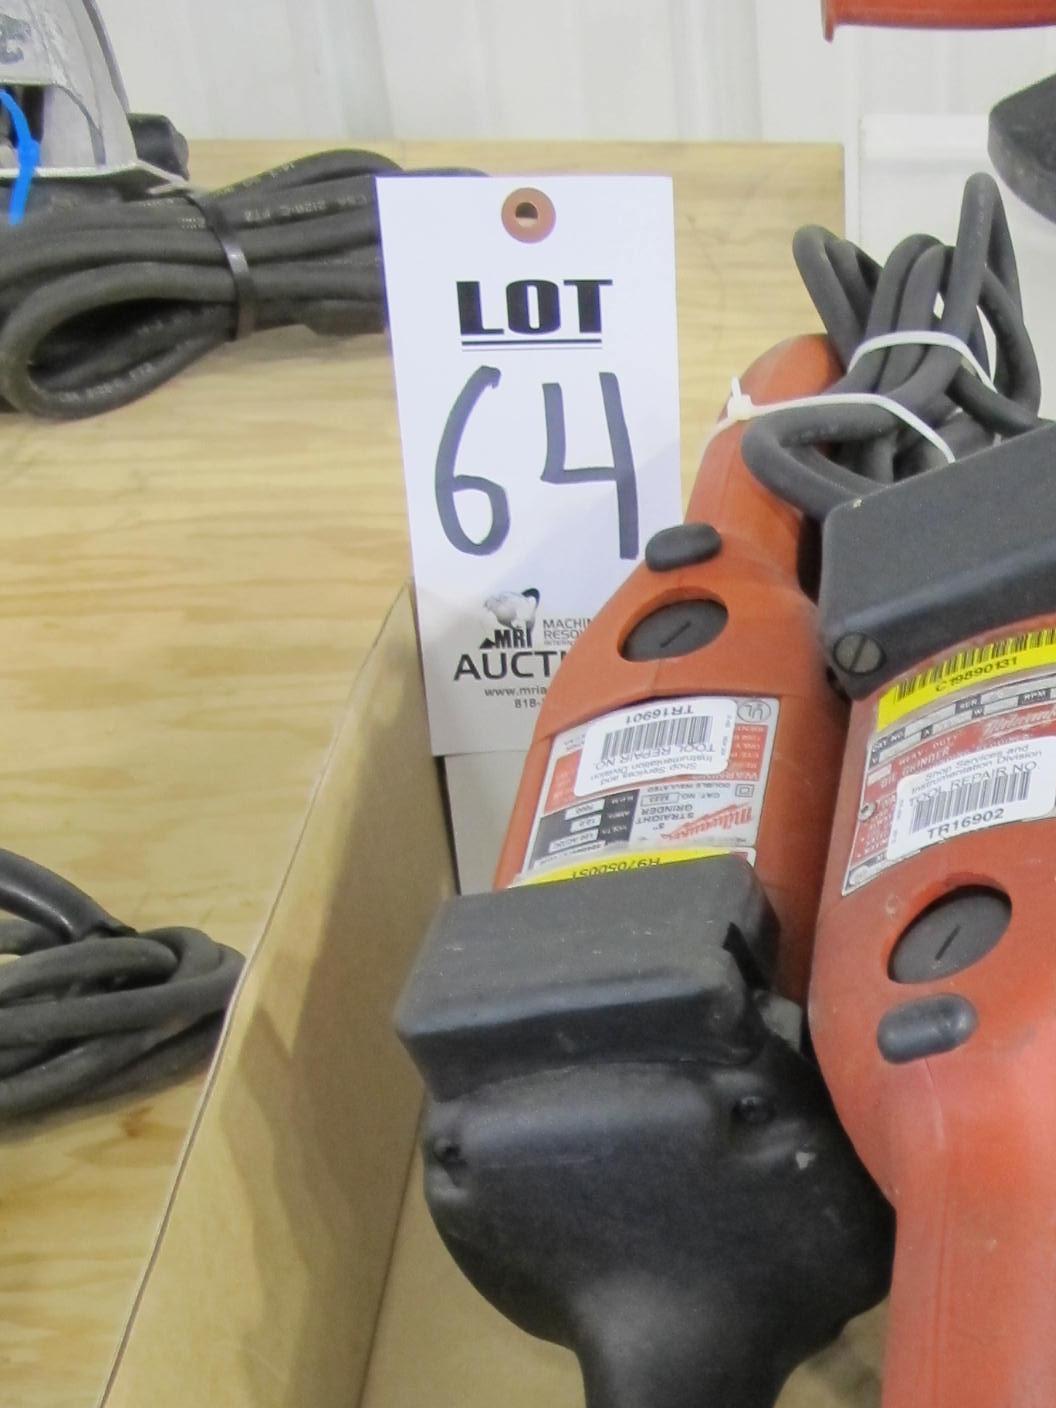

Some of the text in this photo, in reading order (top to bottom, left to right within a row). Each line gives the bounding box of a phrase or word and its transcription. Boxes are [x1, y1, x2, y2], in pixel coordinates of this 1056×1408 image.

[456, 279, 614, 336] LOT
[435, 365, 640, 560] 64
[493, 622, 533, 648] MRI
[514, 698, 545, 709] 818-
[624, 702, 694, 725] TR16901
[619, 746, 672, 763] REPAIR
[678, 743, 716, 754] TOOL
[995, 749, 1043, 767] Division
[925, 743, 1029, 780] Shop Services and
[600, 761, 697, 786] Shop Services and
[646, 783, 692, 793] INSULATED
[908, 785, 943, 807] TOOL
[949, 764, 1008, 793] REPAIR
[635, 812, 694, 825] STRAIGHT
[640, 803, 693, 815] GRINDER
[926, 808, 1005, 840] TR16902
